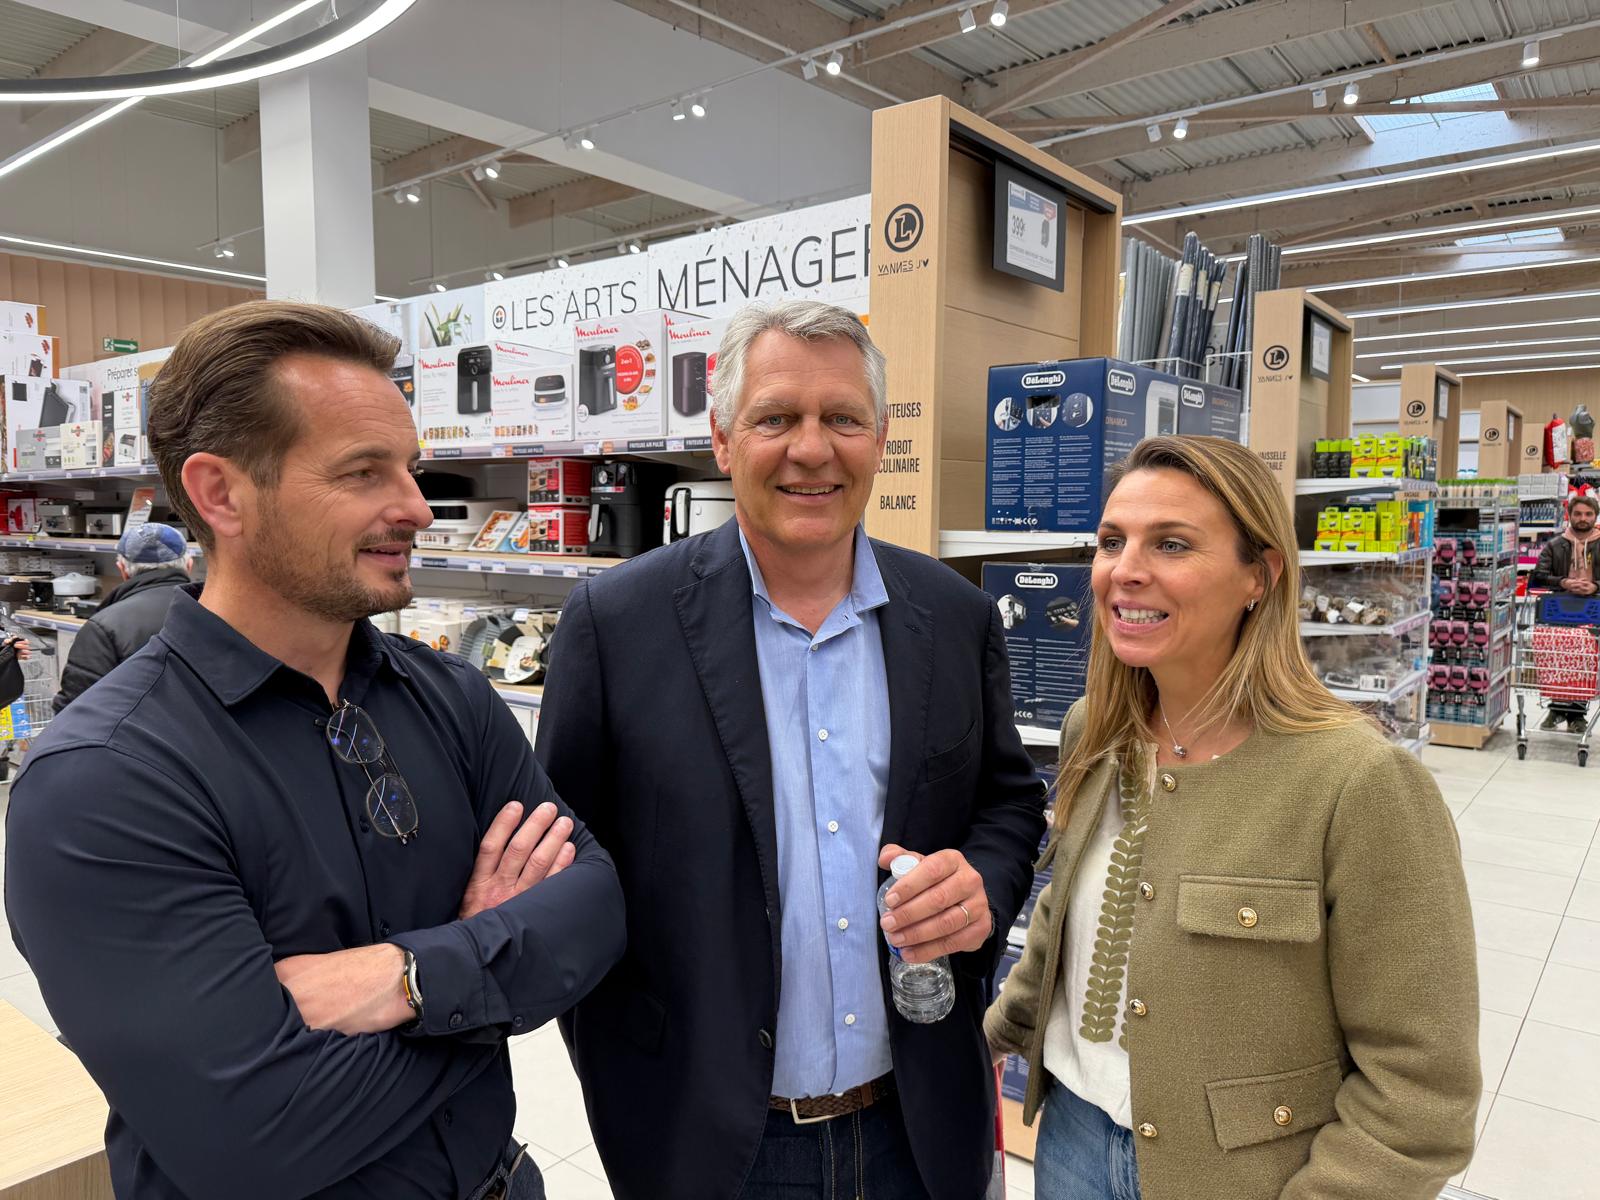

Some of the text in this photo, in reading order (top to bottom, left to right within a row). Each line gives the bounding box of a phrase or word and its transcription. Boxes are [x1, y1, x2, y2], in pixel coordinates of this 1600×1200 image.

[512, 294, 554, 331] LES
[563, 280, 637, 324] ARTS
[576, 324, 619, 338] Moulinex
[669, 328, 712, 340] Moulinex
[418, 358, 456, 370] Moulinex
[107, 367, 133, 383] Préparer
[492, 374, 529, 387] Moulinex
[887, 402, 922, 418] ITEUSES
[886, 440, 912, 455] ROBOT
[879, 458, 920, 473] CULINAIRE
[880, 495, 916, 510] BALANCE
